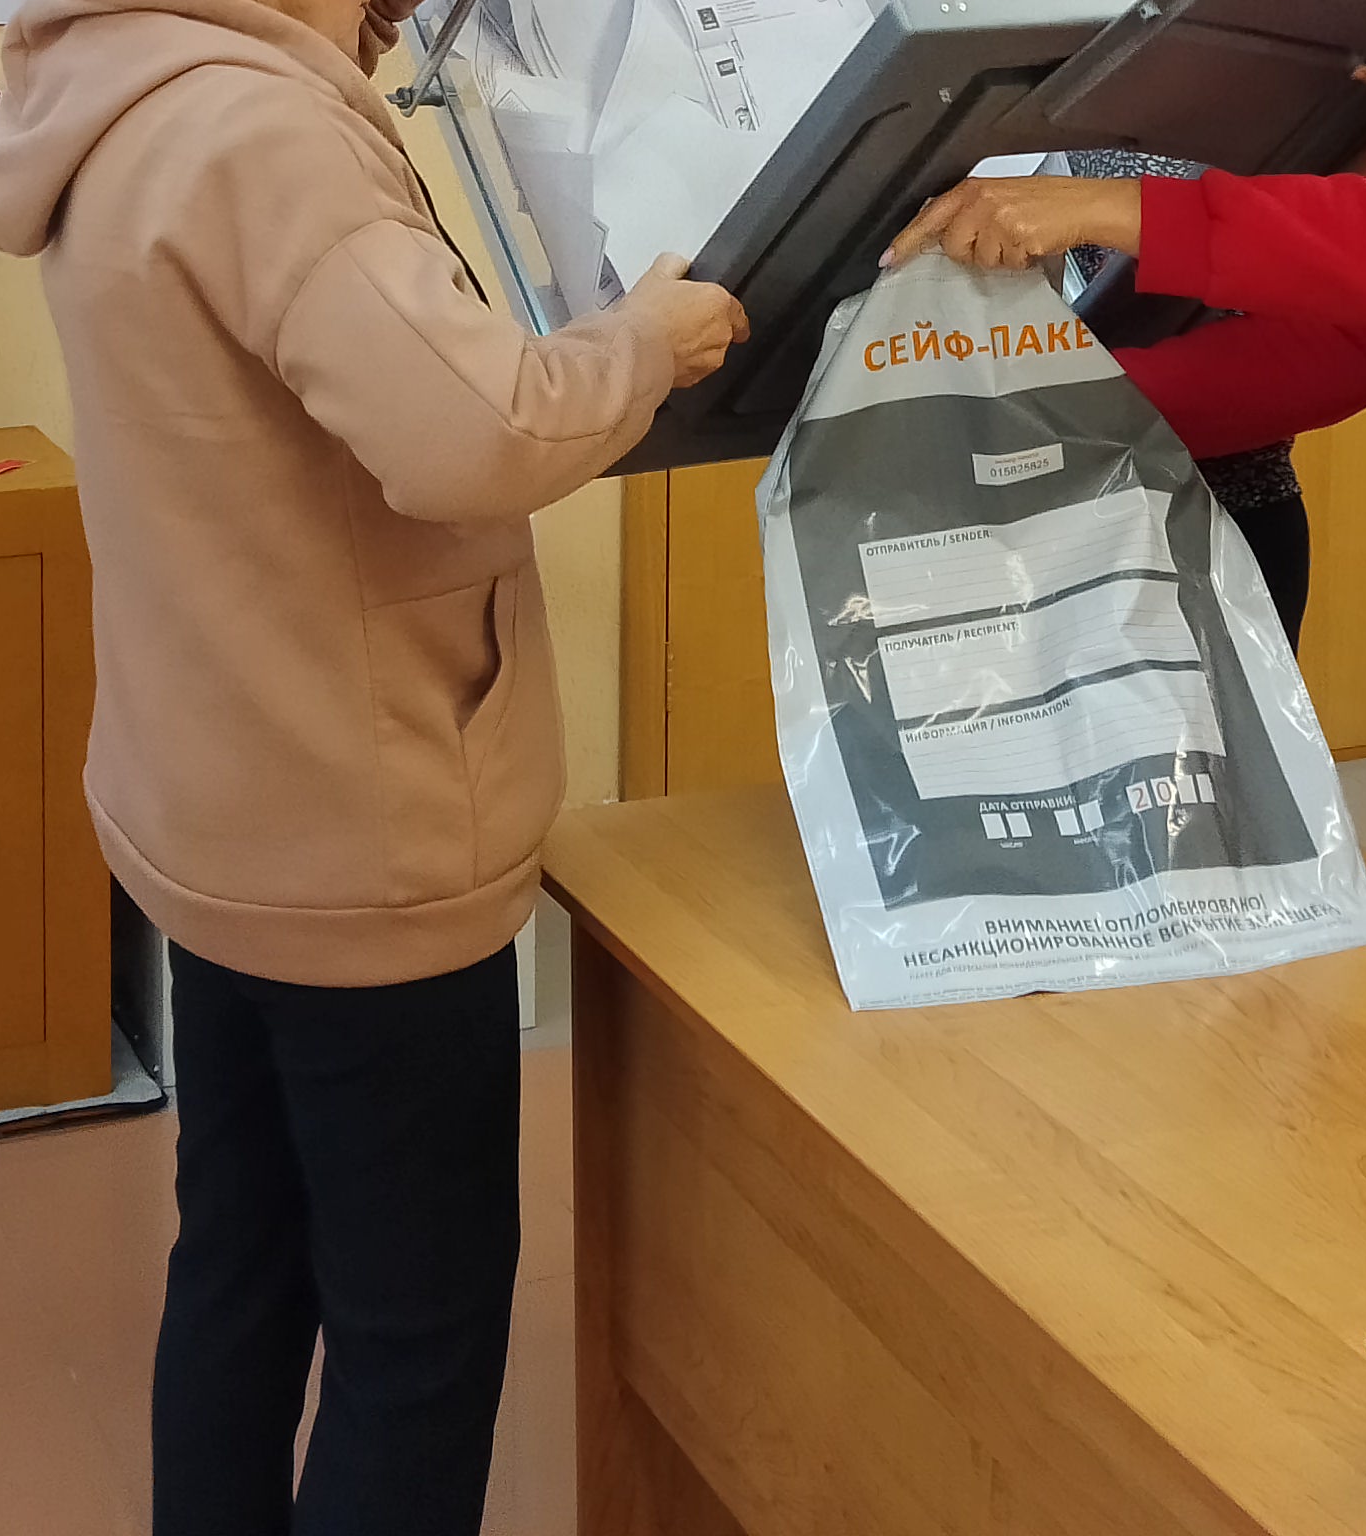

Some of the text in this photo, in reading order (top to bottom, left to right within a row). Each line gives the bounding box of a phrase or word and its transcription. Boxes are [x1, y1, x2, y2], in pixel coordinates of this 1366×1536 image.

[866, 536, 940, 557] ОТПРАВИТЕЛЬ
[885, 631, 954, 653] ПОЛУЧАТЕЛЬ
[979, 801, 1009, 813] ДАТА
[985, 918, 1101, 935] ВНИМАНИЕ!
[903, 933, 1156, 968] НЕСАНКЦИОНИРОВАННОЕ
[1158, 914, 1243, 943] ВСКРЫТИЕ
